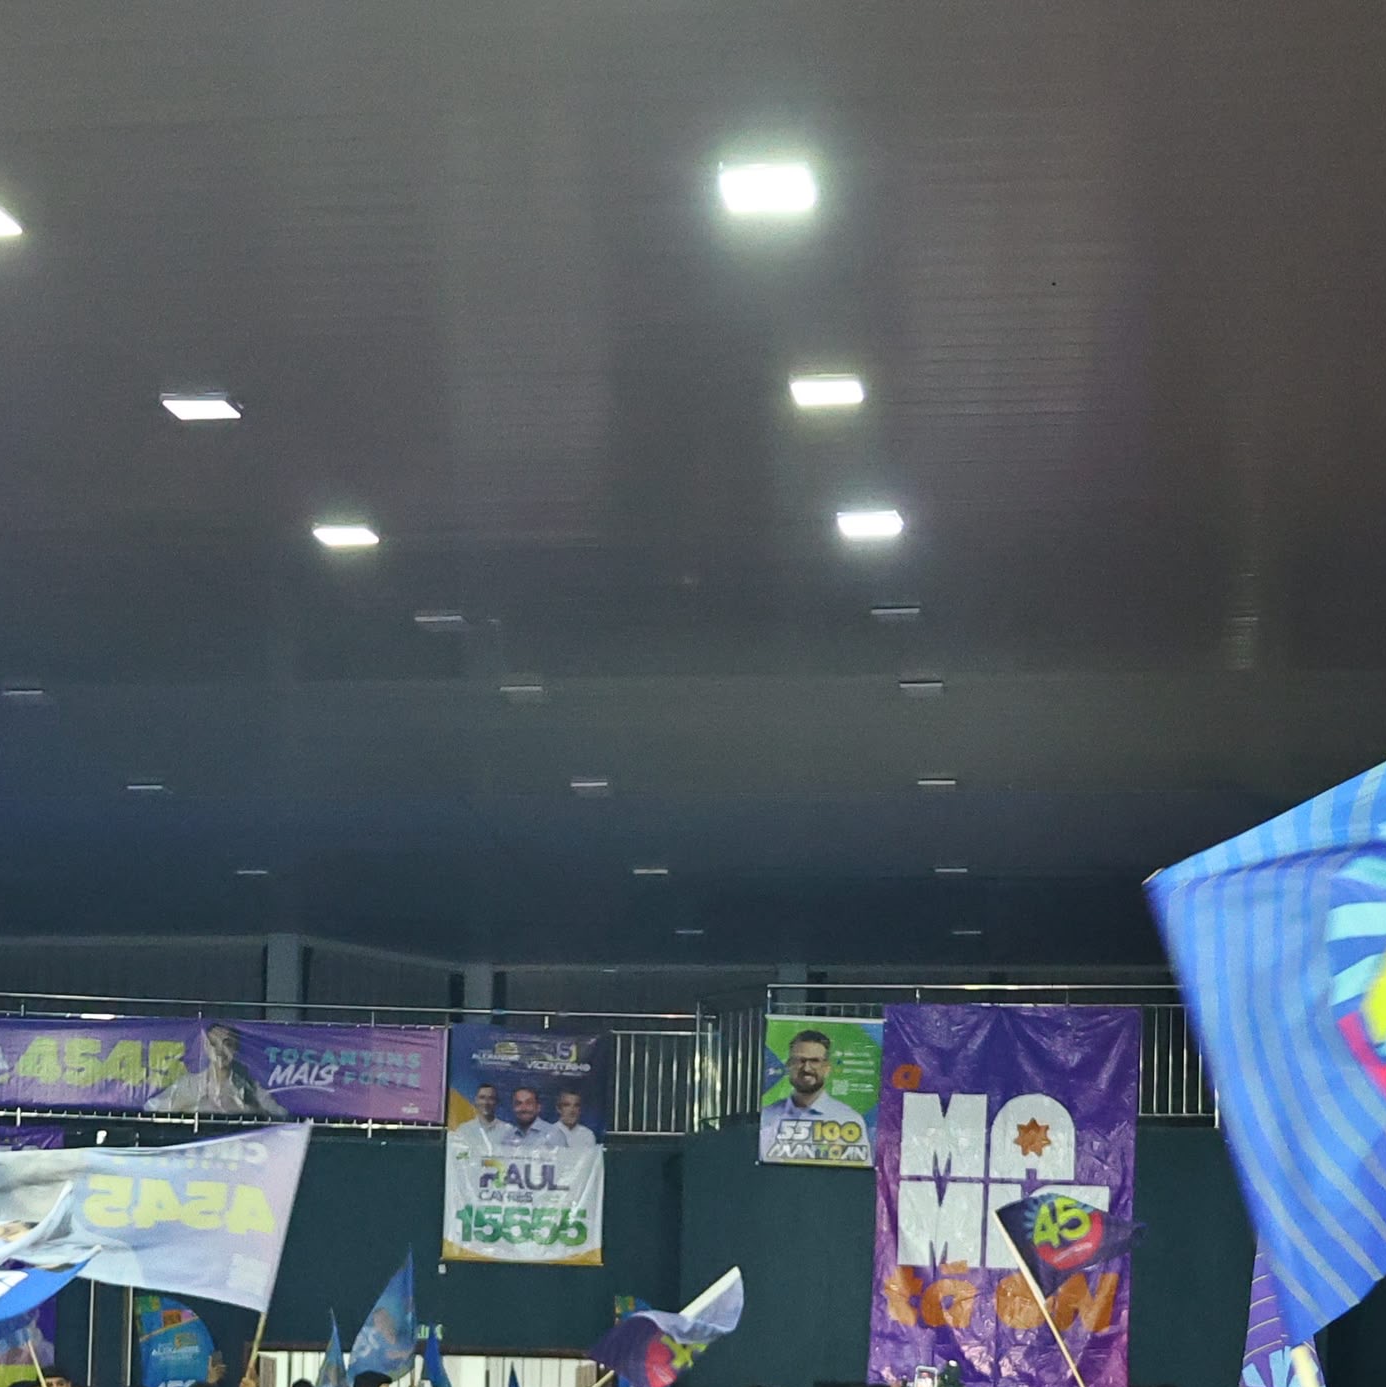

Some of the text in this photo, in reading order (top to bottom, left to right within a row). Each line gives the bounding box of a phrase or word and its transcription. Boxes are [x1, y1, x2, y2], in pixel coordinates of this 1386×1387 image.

[14, 1036, 188, 1088] 4545
[268, 1064, 340, 1086] MAIS
[777, 1120, 862, 1144] 55100
[479, 1158, 570, 1191] RAUL
[1033, 1197, 1093, 1250] 45
